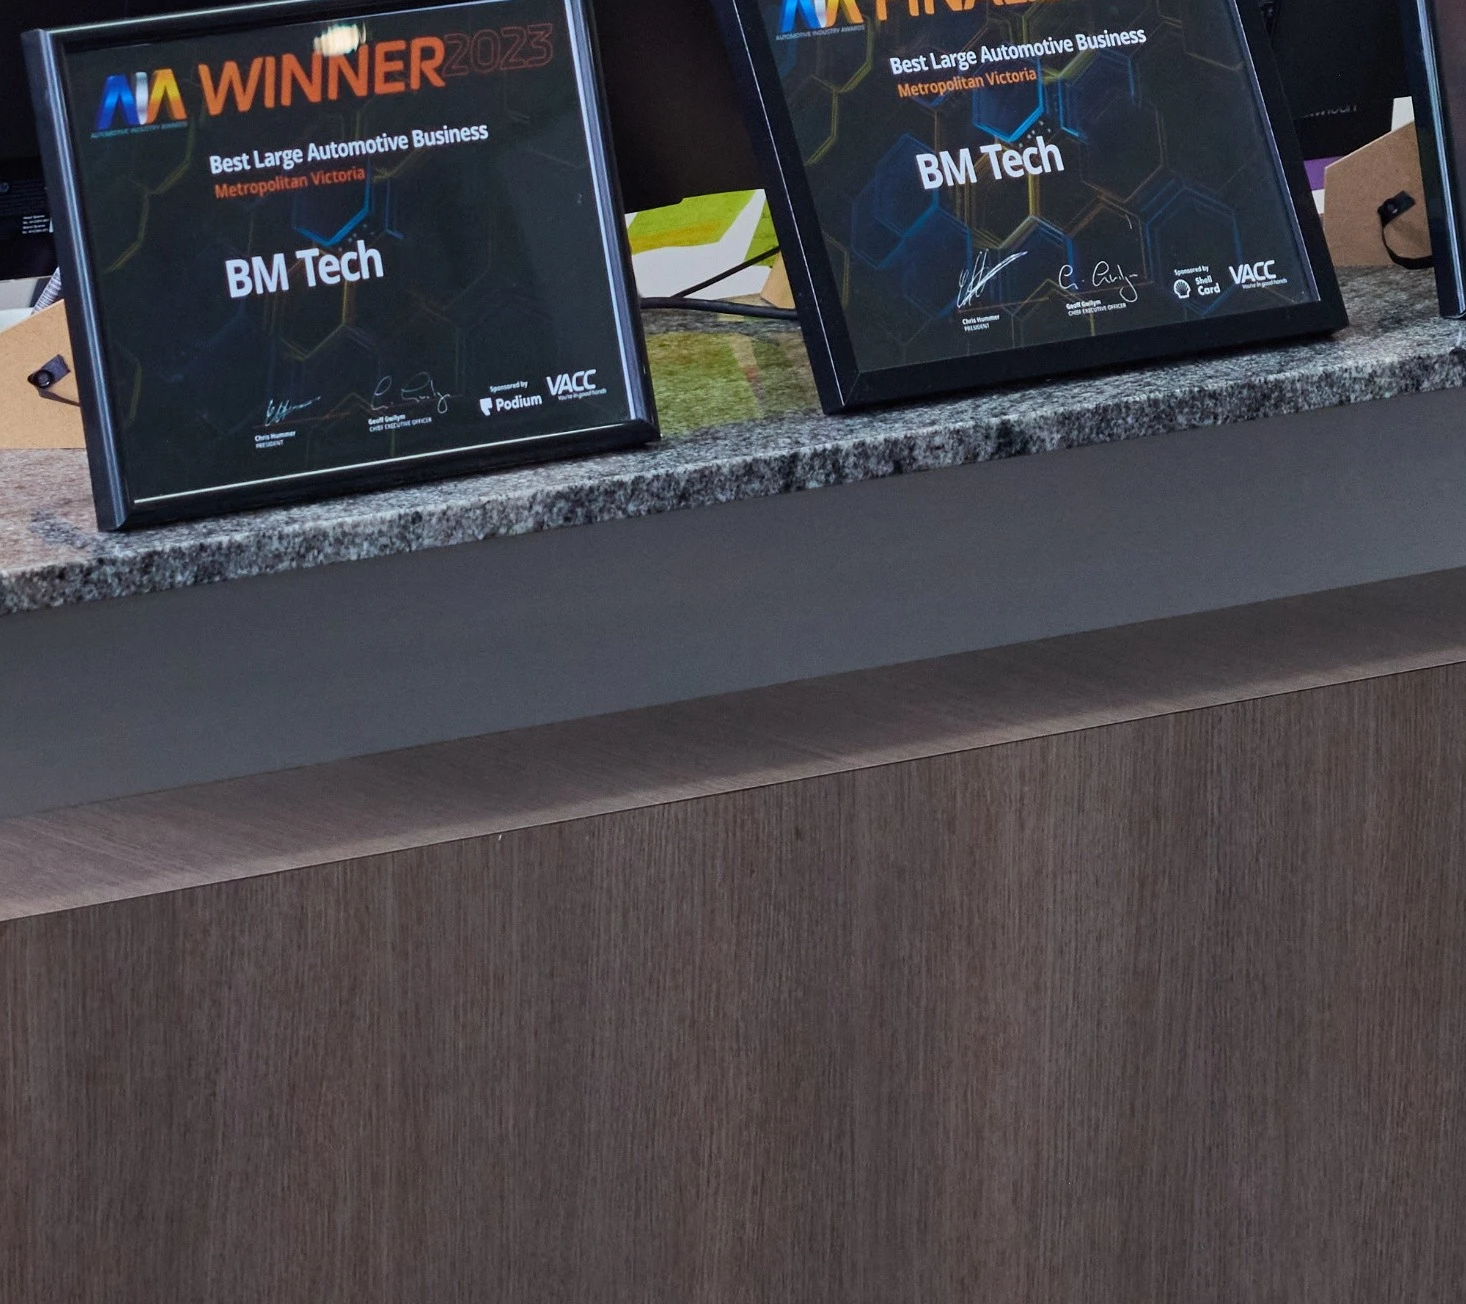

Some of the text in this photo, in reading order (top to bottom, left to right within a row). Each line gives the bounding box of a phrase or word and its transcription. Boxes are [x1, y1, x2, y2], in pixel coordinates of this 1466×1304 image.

[889, 28, 1147, 75] Best Large Automotive Business
[197, 22, 555, 117] WINNER 2023
[897, 67, 1037, 98] Metropolitan Victoria
[209, 123, 490, 175] Best Large Automotive Business
[915, 135, 1065, 190] BM Tech
[214, 165, 367, 200] Metropolitan Victoria
[224, 239, 385, 299] BM Tech
[1194, 274, 1213, 285] Shell
[1228, 259, 1277, 285] VACC
[1197, 282, 1221, 296] Card
[962, 317, 977, 325] Chris
[546, 368, 597, 396] VACC
[495, 393, 543, 412] Podium
[384, 419, 411, 430] EXECUTIVE
[411, 416, 433, 426] OFFICER
[254, 433, 270, 442] Chris
